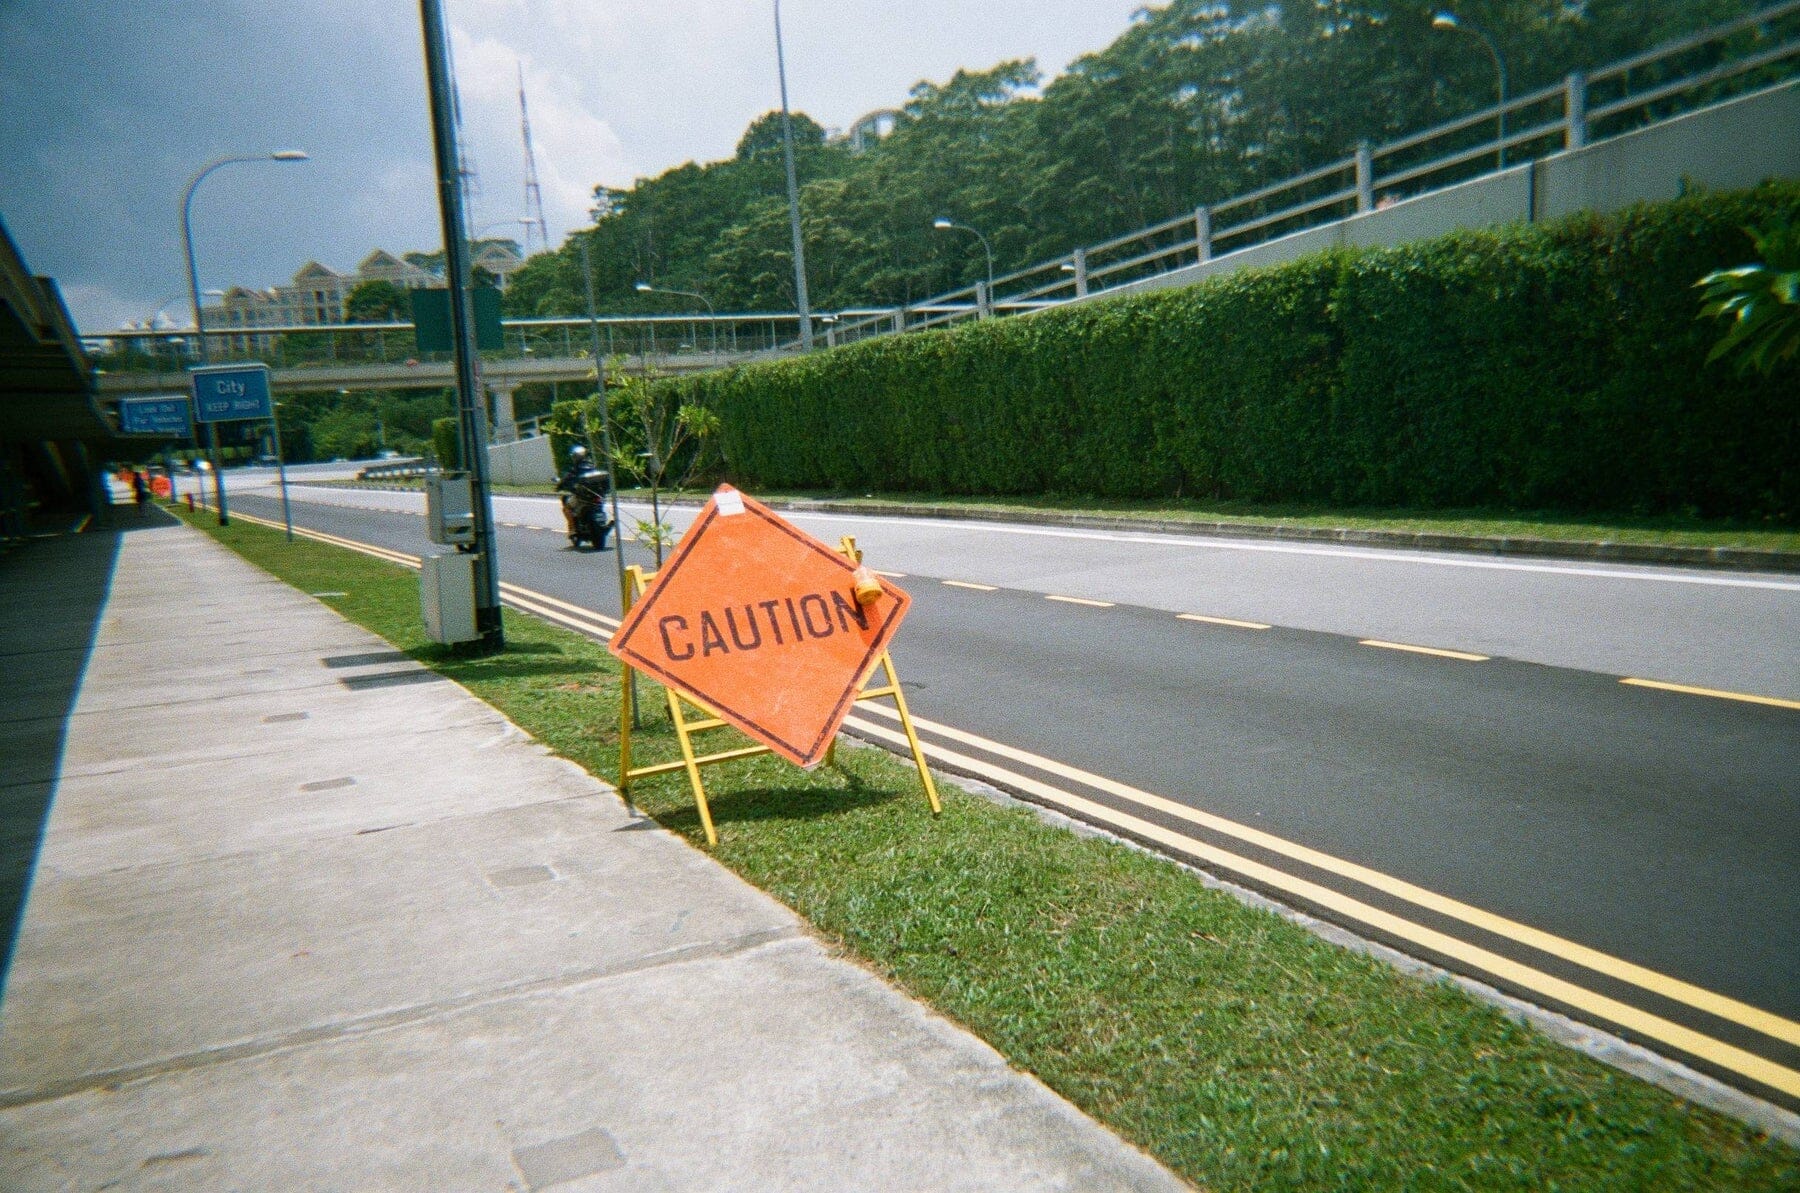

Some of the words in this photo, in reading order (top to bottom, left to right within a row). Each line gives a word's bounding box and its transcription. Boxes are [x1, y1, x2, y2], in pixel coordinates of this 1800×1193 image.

[216, 380, 245, 396] City
[206, 401, 229, 412] KEEP
[659, 588, 870, 661] CAUTION
